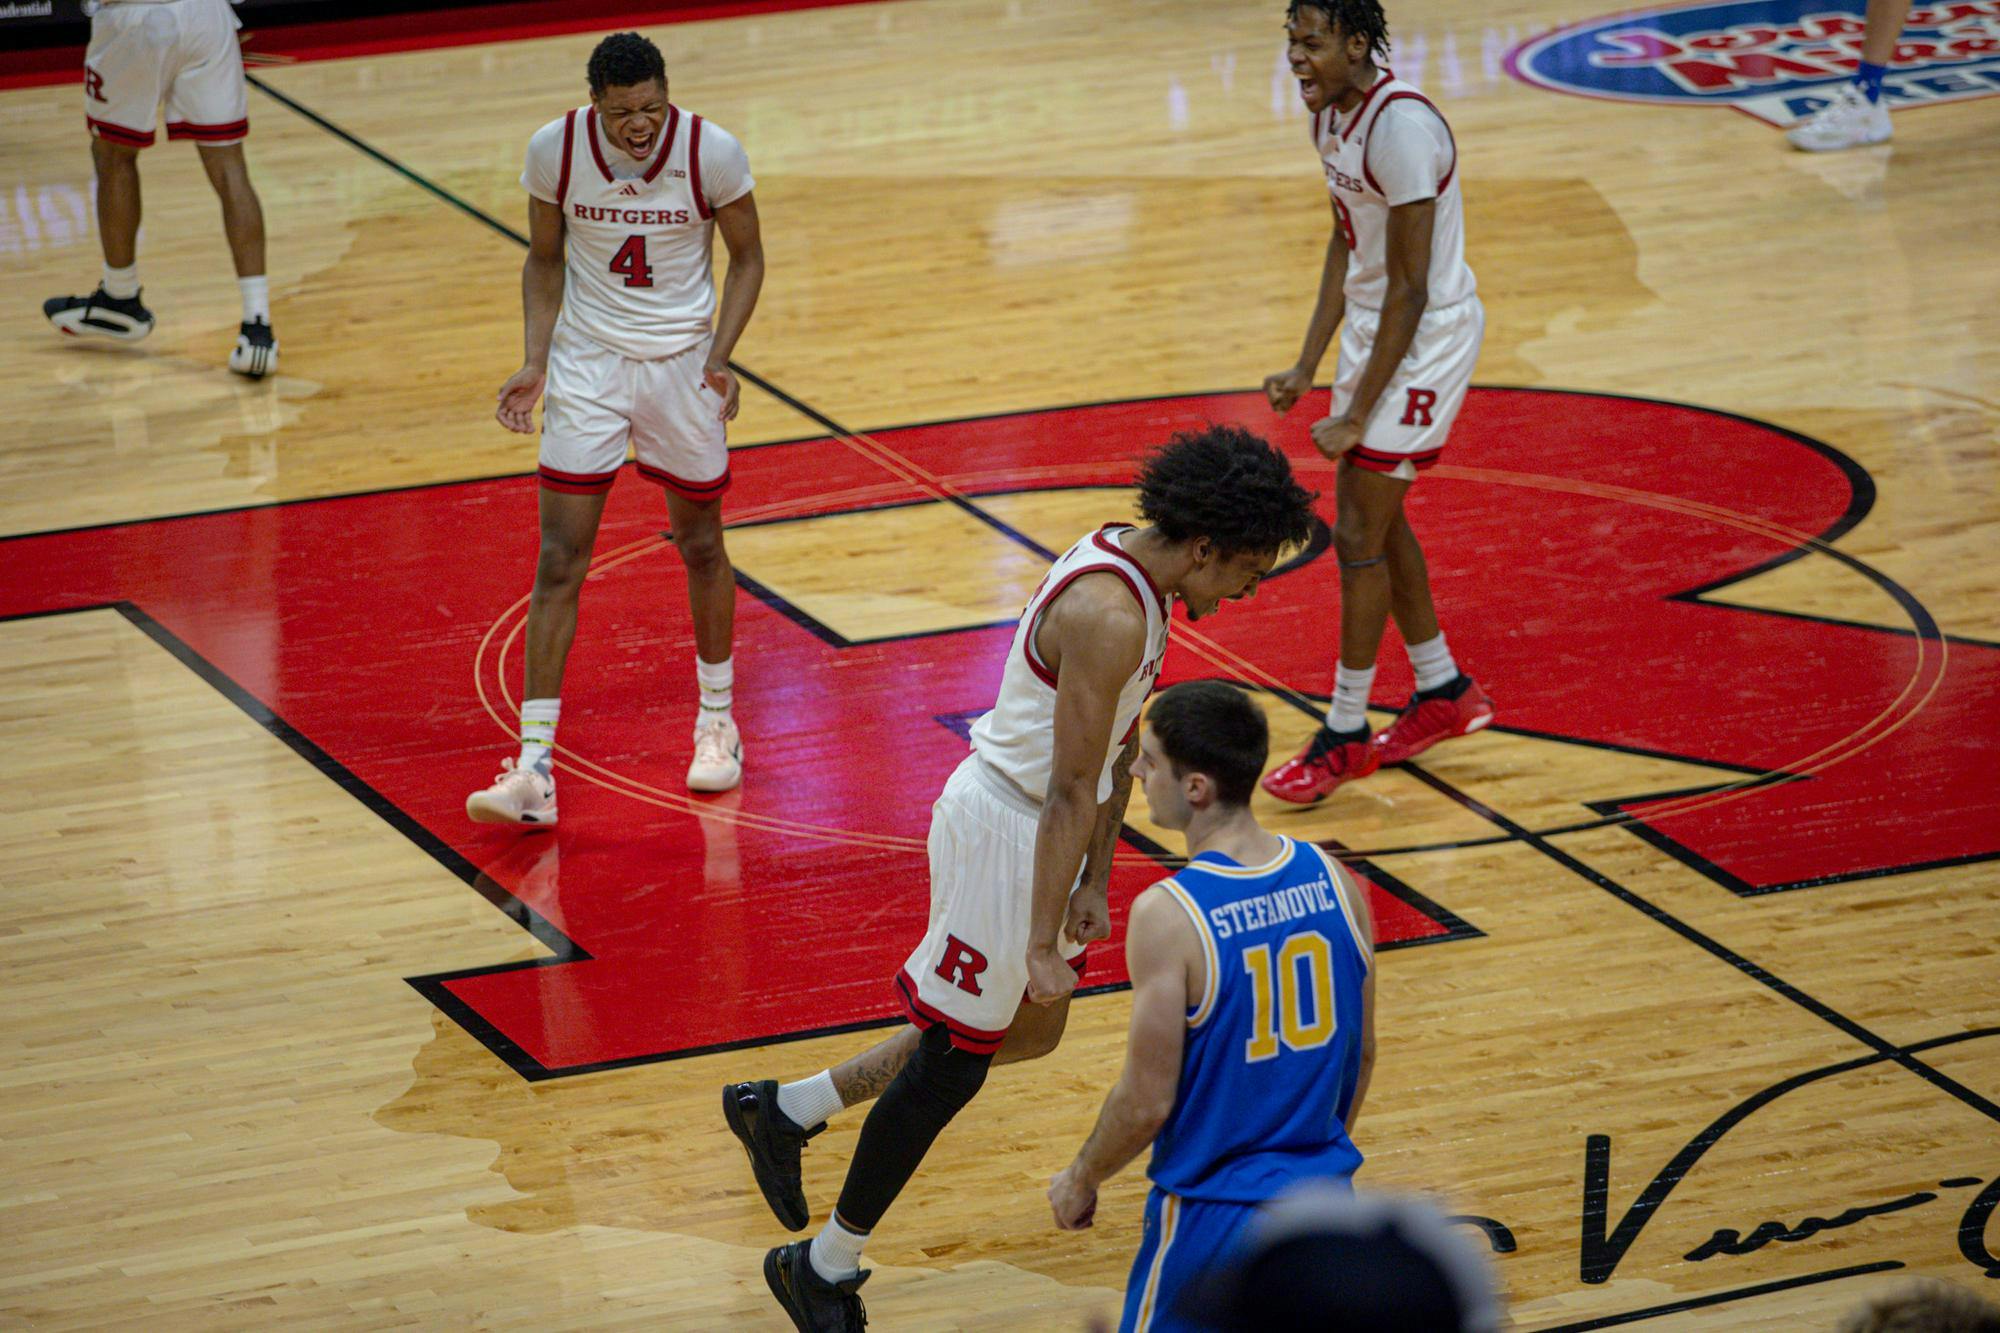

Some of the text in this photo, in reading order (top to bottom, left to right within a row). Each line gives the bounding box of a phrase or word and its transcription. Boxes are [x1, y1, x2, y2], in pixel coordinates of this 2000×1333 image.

[86, 64, 109, 104] R
[574, 203, 690, 225] RUTGERS
[609, 234, 654, 288] 4
[1399, 387, 1436, 426] R
[1210, 872, 1336, 940] STEFANOVIĆ
[934, 932, 989, 998] R
[1242, 930, 1338, 1063] 10
